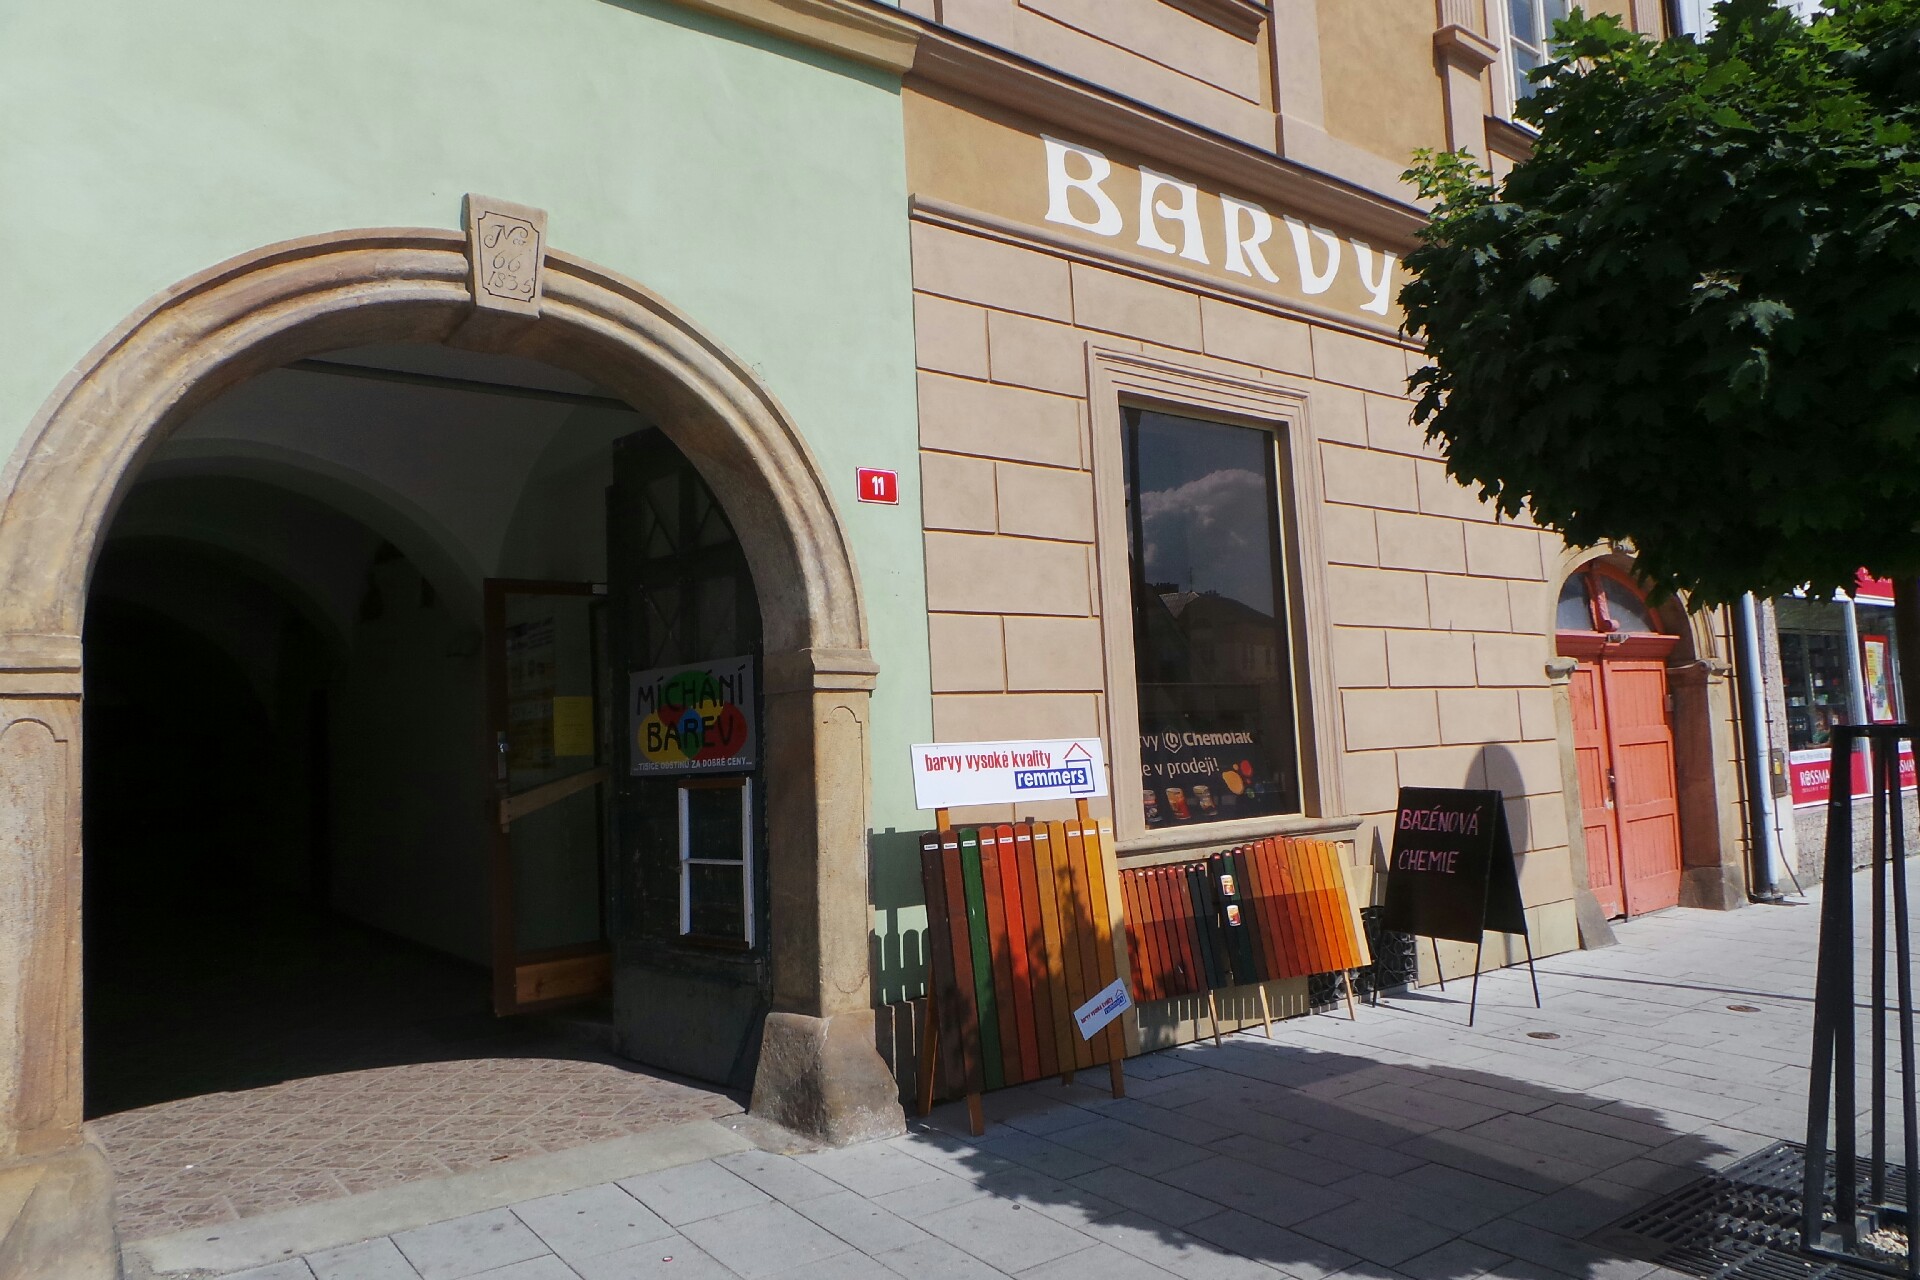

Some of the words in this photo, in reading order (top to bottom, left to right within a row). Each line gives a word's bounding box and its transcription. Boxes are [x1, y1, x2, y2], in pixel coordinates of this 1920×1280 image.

[871, 475, 885, 496] 11
[637, 664, 746, 716] MÍCHÁNÍ
[647, 715, 734, 753] BAREV
[1182, 732, 1254, 747] Chemolak
[691, 759, 701, 769] ZA
[702, 757, 726, 767] DOBRÉ
[924, 753, 962, 773] barvy
[964, 750, 1009, 772] vysoké
[1010, 750, 1051, 769] kvality
[1154, 763, 1163, 776] v
[1167, 757, 1220, 778] prodeji!
[1016, 768, 1086, 789] remmers
[1799, 769, 1830, 787] ROSSMA
[1400, 805, 1482, 836] BAZÉNOVÁ
[1398, 849, 1460, 874] CHEMIE
